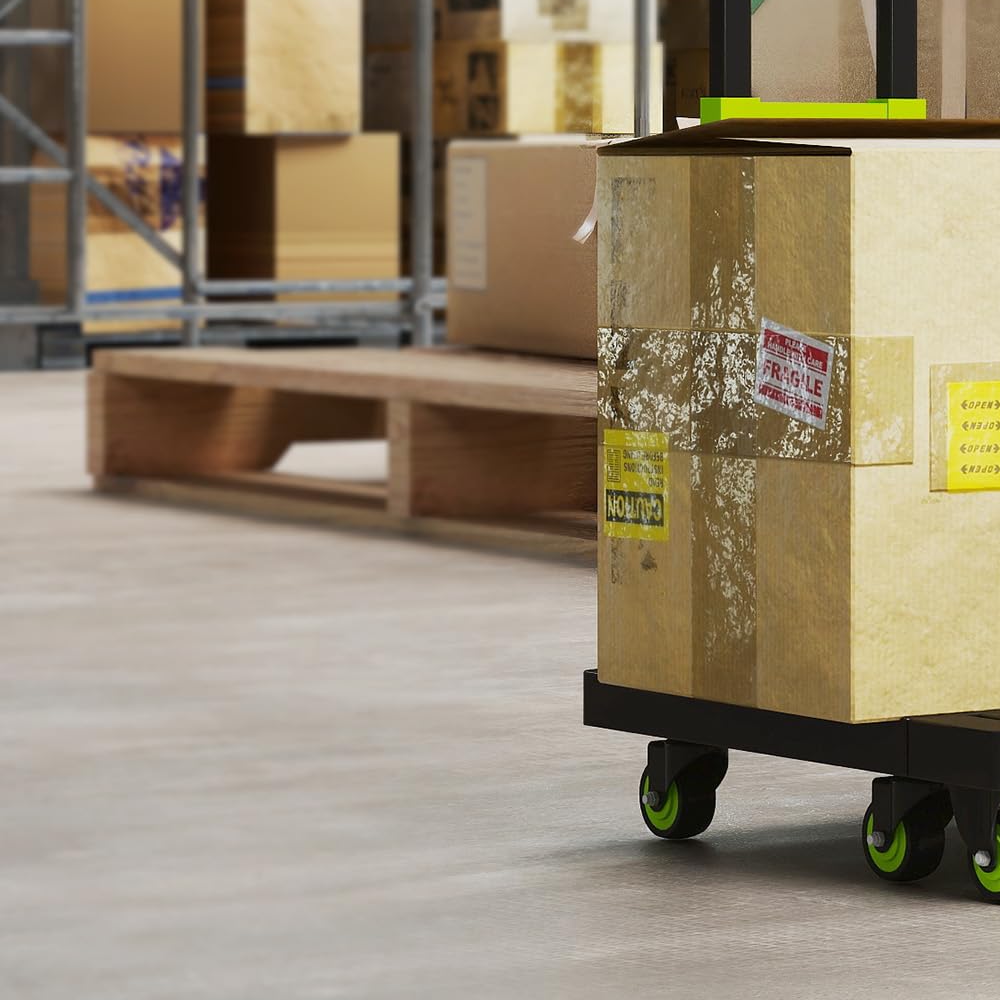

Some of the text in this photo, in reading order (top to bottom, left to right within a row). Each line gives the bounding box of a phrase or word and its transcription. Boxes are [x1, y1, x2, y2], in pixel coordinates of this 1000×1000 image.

[807, 356, 824, 369] CARE
[762, 359, 824, 398] FRAGILE
[968, 401, 994, 409] OPEN
[969, 422, 995, 430] OPEN
[966, 444, 992, 453] OPEN
[968, 465, 994, 473] OPEN
[607, 494, 662, 522] CAUTION
